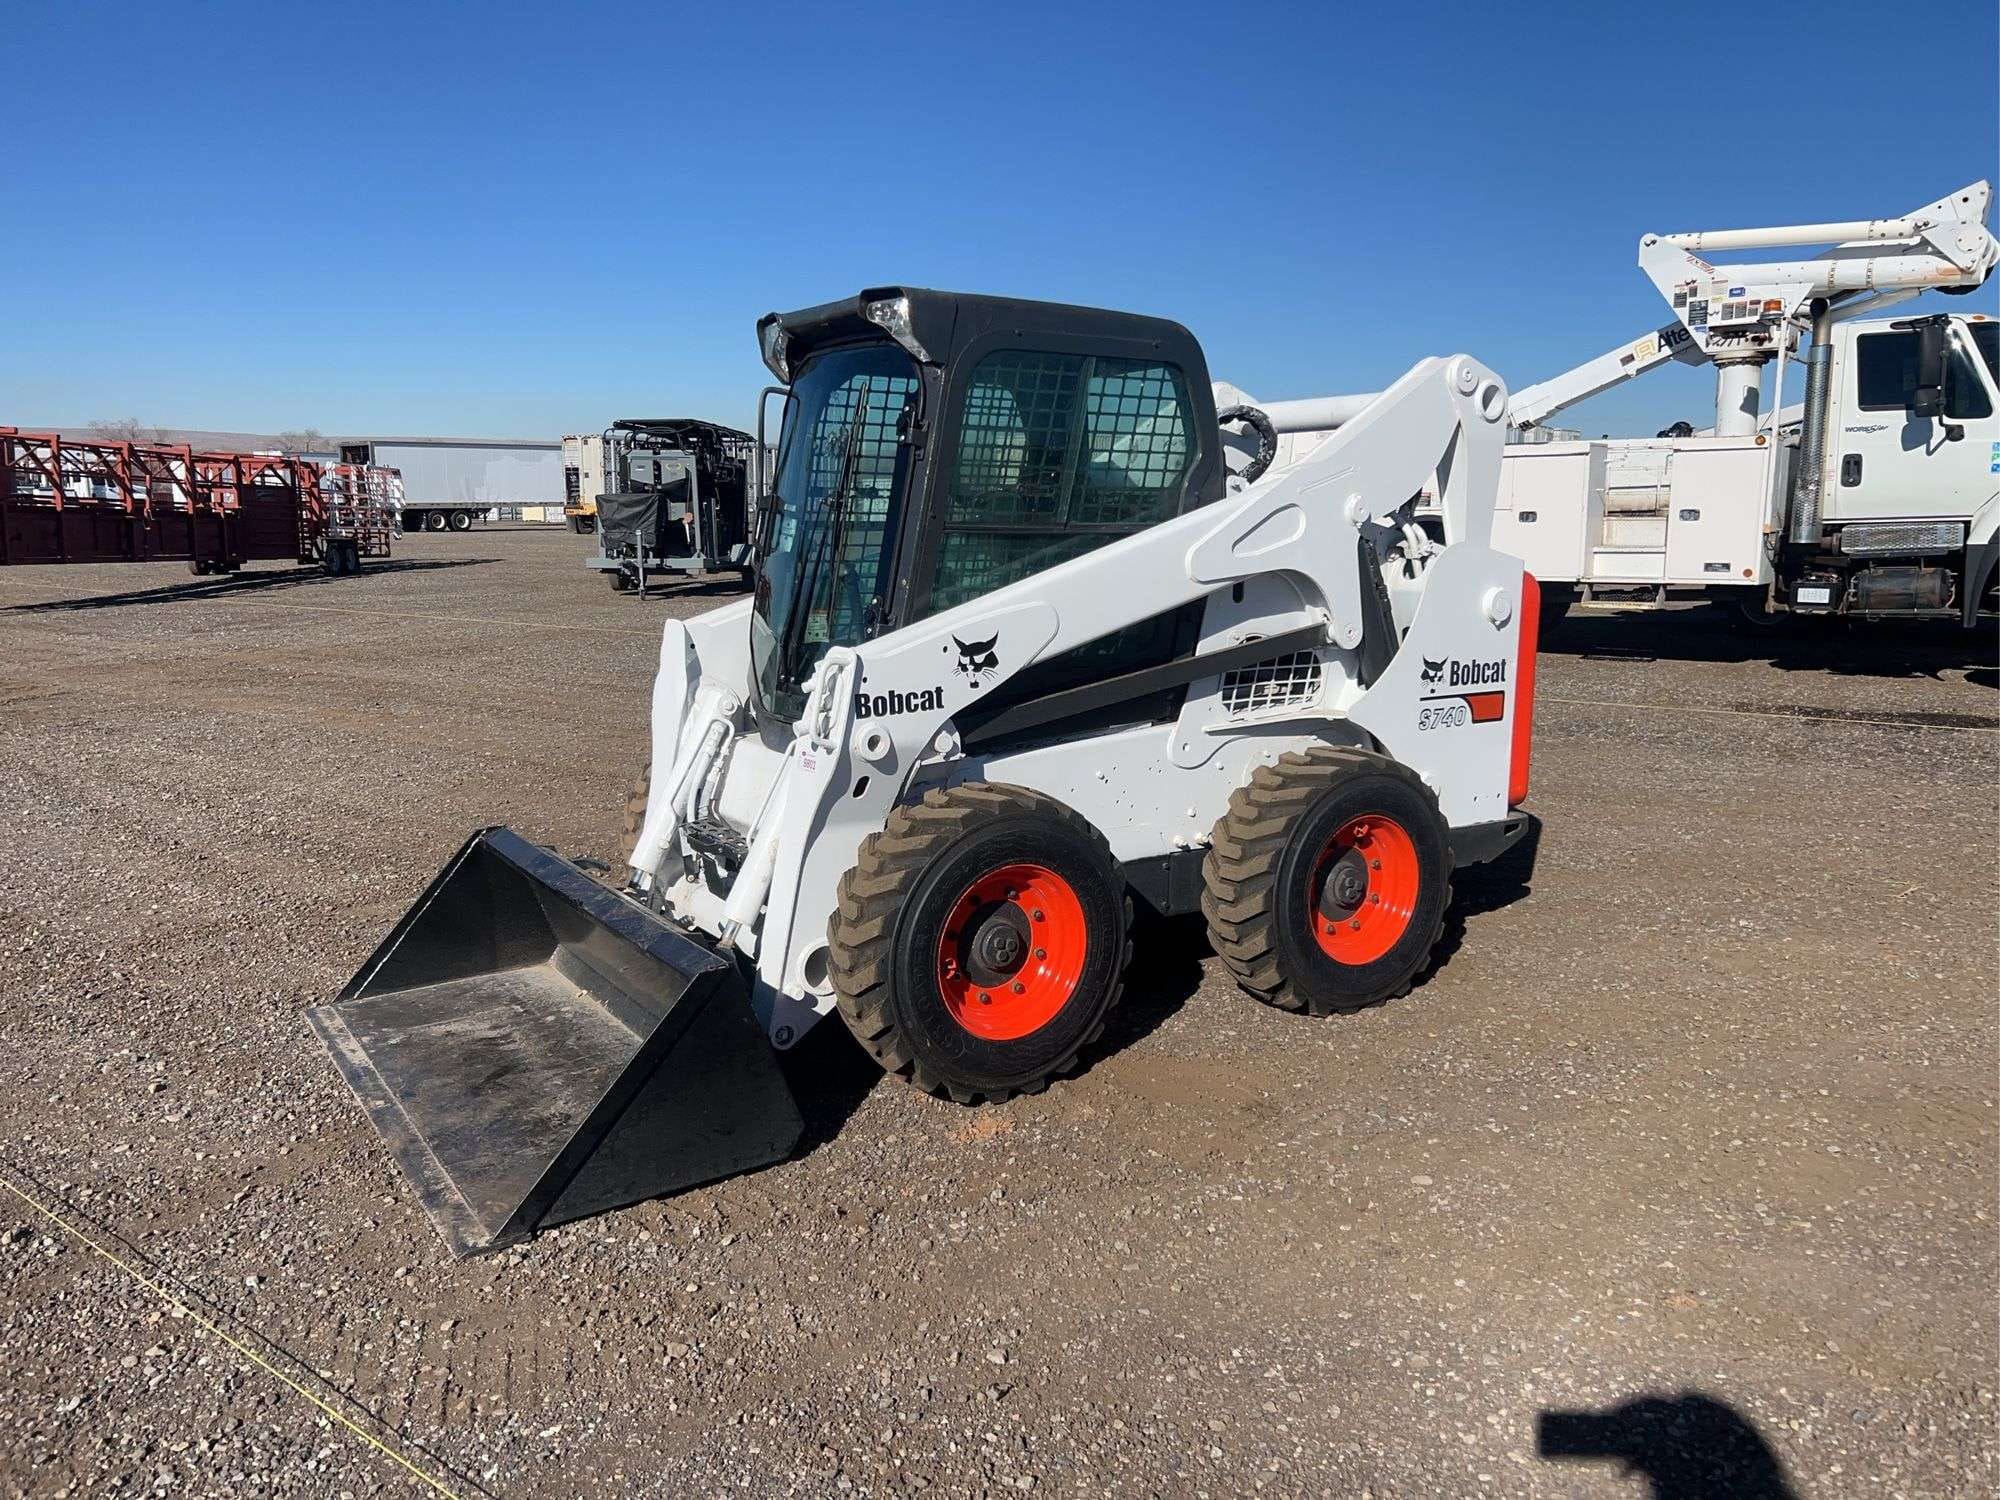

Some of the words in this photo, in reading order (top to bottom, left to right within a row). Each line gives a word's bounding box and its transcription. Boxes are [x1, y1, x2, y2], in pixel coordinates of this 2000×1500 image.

[1658, 328, 1692, 353] Alte
[1449, 658, 1507, 687] Bobcat
[854, 686, 945, 720] Bobcat
[1418, 705, 1467, 731] S740
